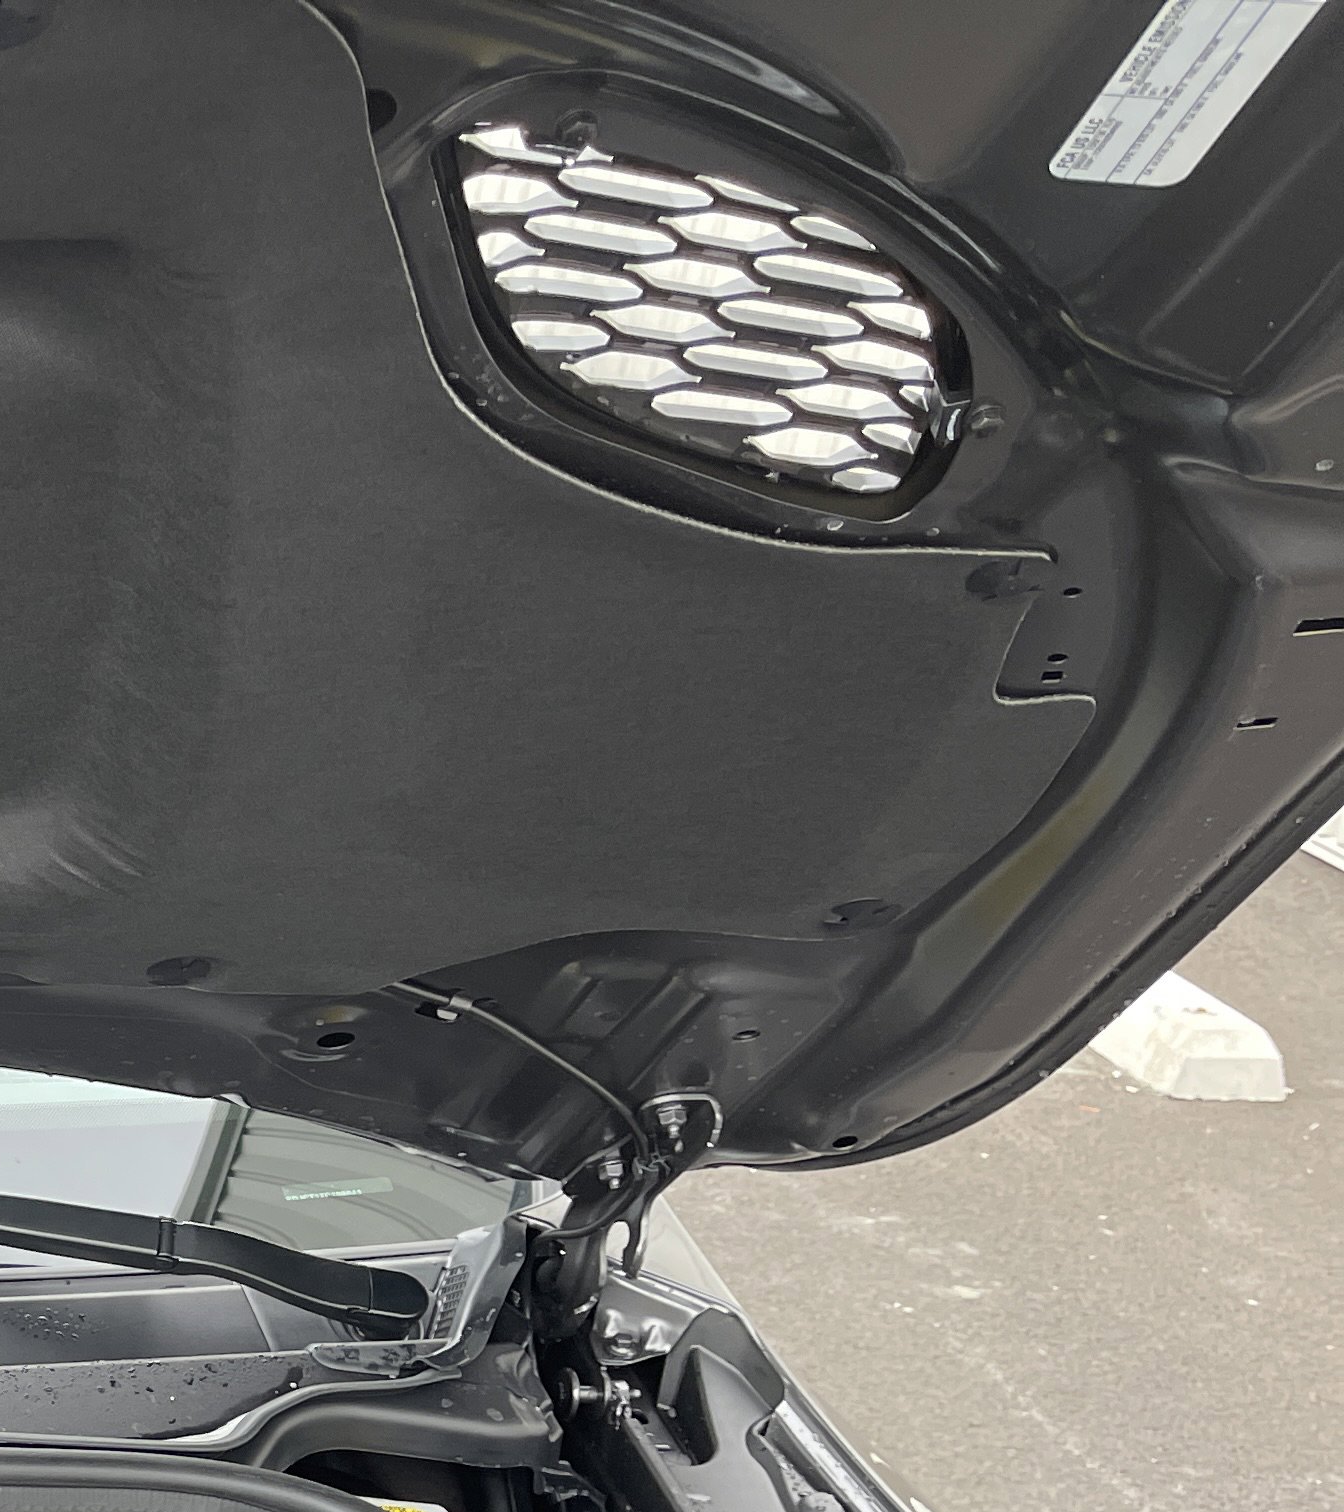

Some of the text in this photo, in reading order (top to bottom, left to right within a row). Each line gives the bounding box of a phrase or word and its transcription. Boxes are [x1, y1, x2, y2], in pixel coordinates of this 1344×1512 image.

[1056, 151, 1080, 168] FCA
[1070, 136, 1089, 149] US
[1080, 118, 1104, 135] LLC
